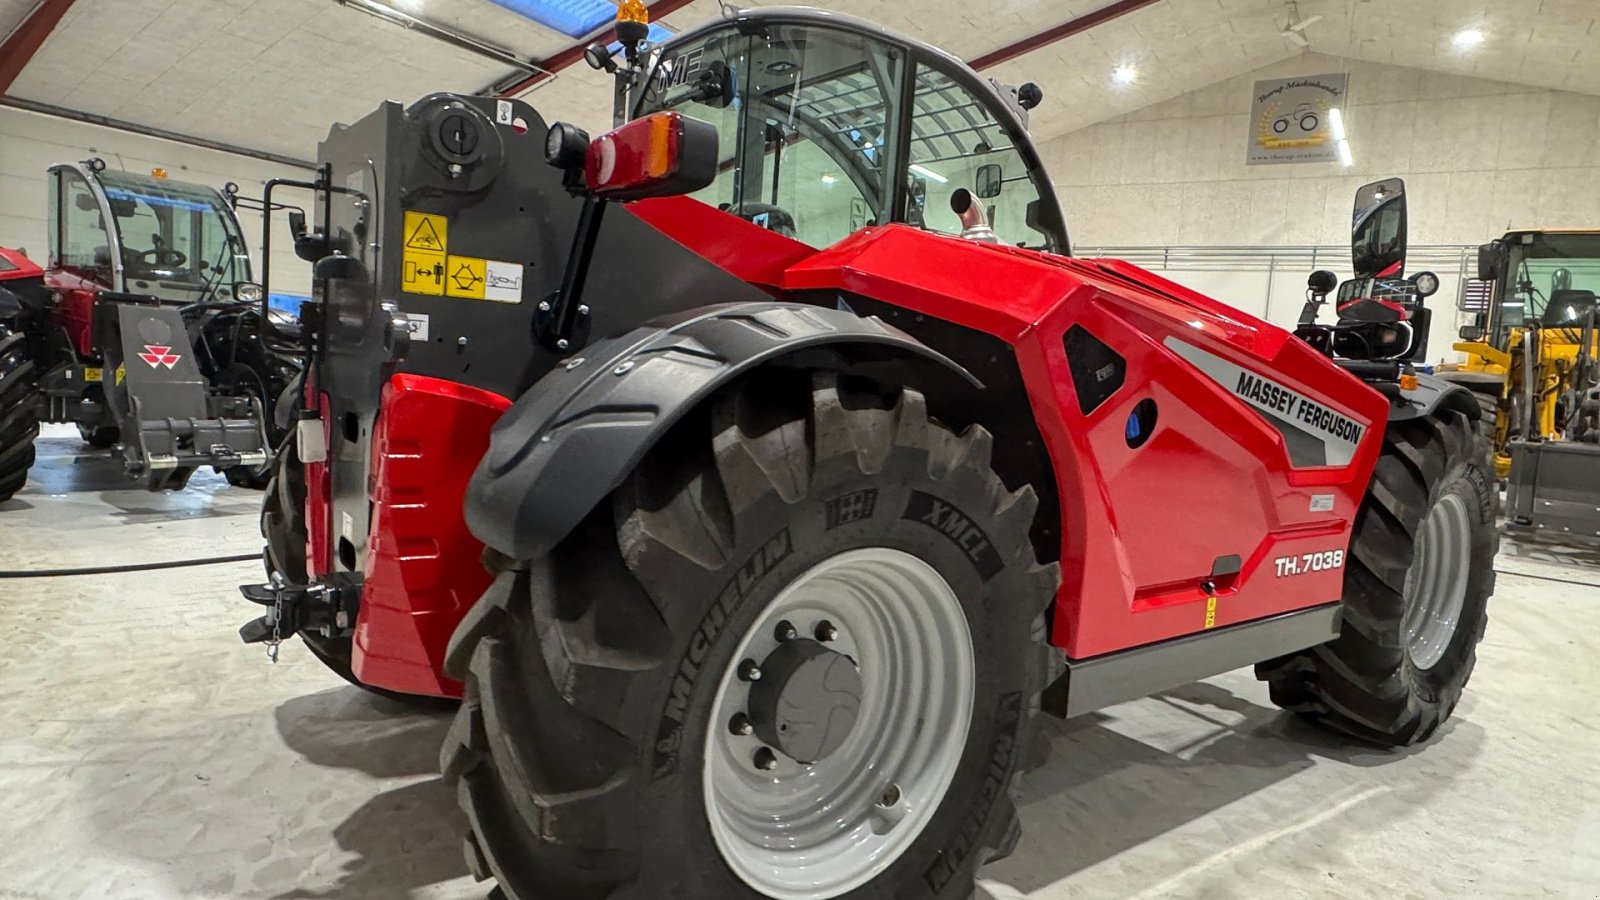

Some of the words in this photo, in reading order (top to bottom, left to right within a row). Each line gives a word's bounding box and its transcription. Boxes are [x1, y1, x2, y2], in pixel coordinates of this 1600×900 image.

[657, 47, 704, 93] MF
[1236, 371, 1297, 414] MASSEY
[1296, 399, 1363, 446] FERGUSON
[921, 500, 989, 562] XMCL
[1274, 549, 1344, 578] TH.7038
[665, 530, 793, 722] MICHELIN
